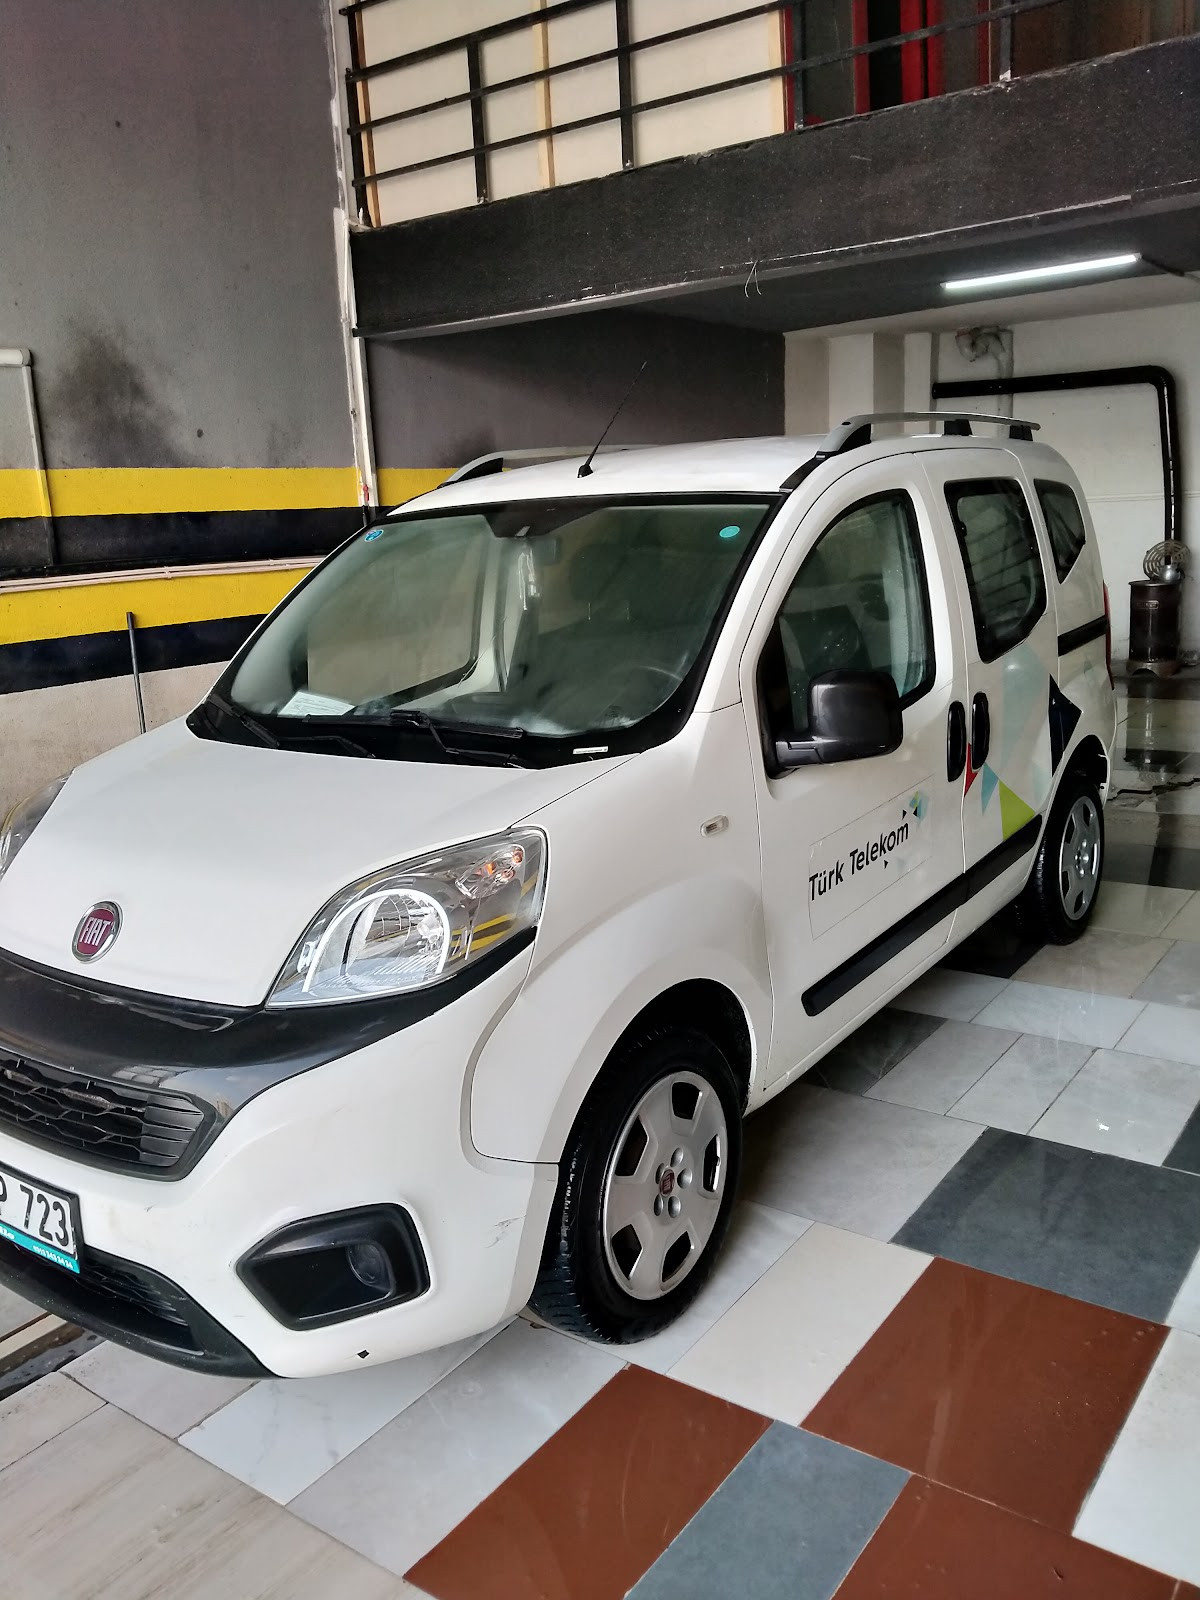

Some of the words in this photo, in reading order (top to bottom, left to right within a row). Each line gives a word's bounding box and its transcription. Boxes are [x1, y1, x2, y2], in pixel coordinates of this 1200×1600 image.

[809, 860, 845, 901] Türk
[849, 822, 909, 875] Telekom
[79, 916, 112, 947] FIAT
[20, 1183, 69, 1247] 723
